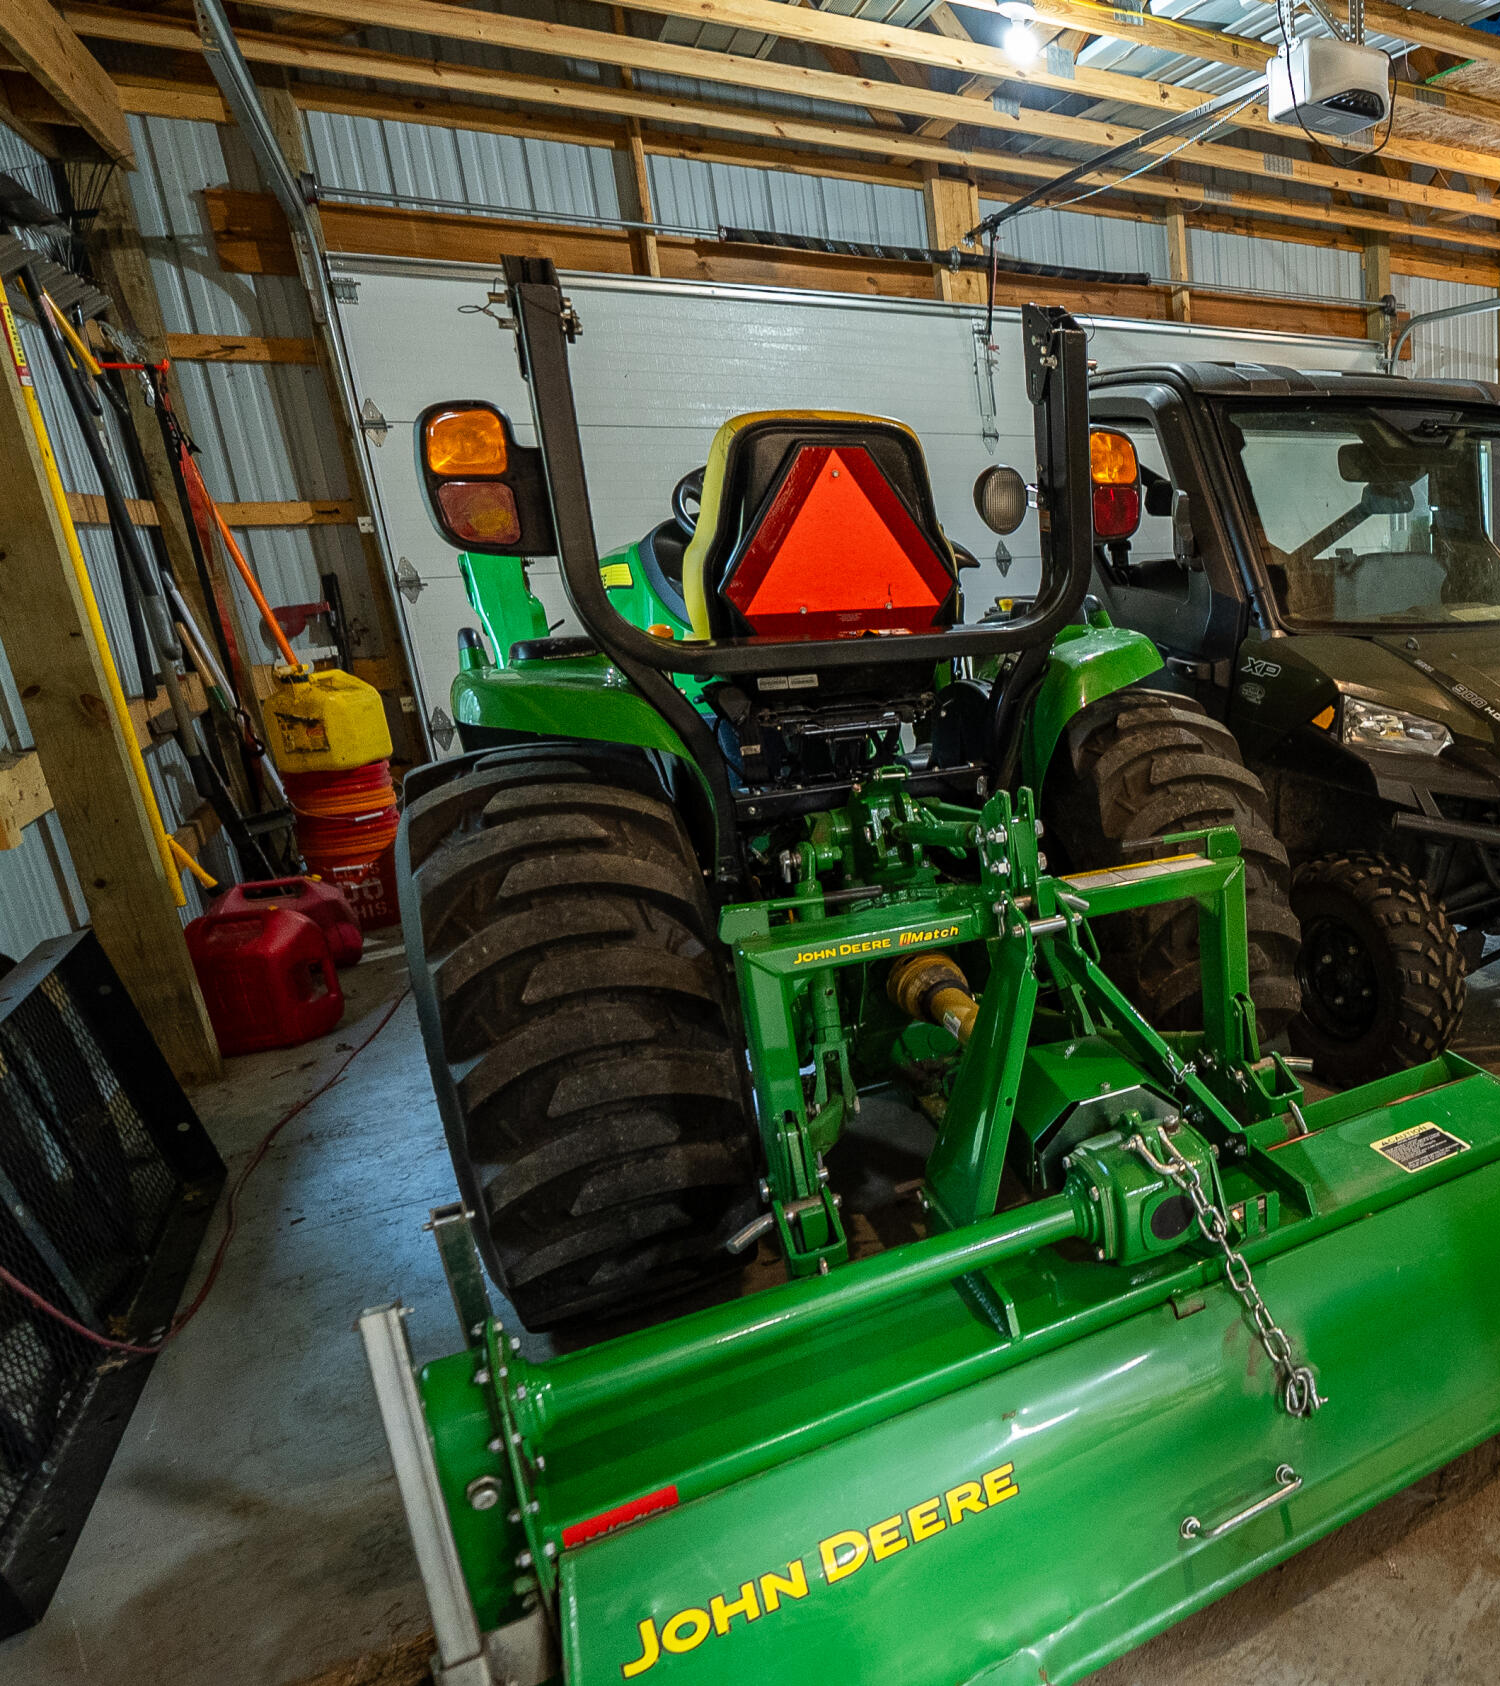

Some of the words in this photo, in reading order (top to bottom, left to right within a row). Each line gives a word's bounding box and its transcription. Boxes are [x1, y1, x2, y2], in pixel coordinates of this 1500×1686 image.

[1241, 656, 1282, 677] XP
[1452, 683, 1488, 708] 900
[793, 948, 837, 965] JOHN
[839, 938, 892, 956] DEERE
[620, 1558, 810, 1680] JOHN
[818, 1461, 1020, 1584] DEERE
